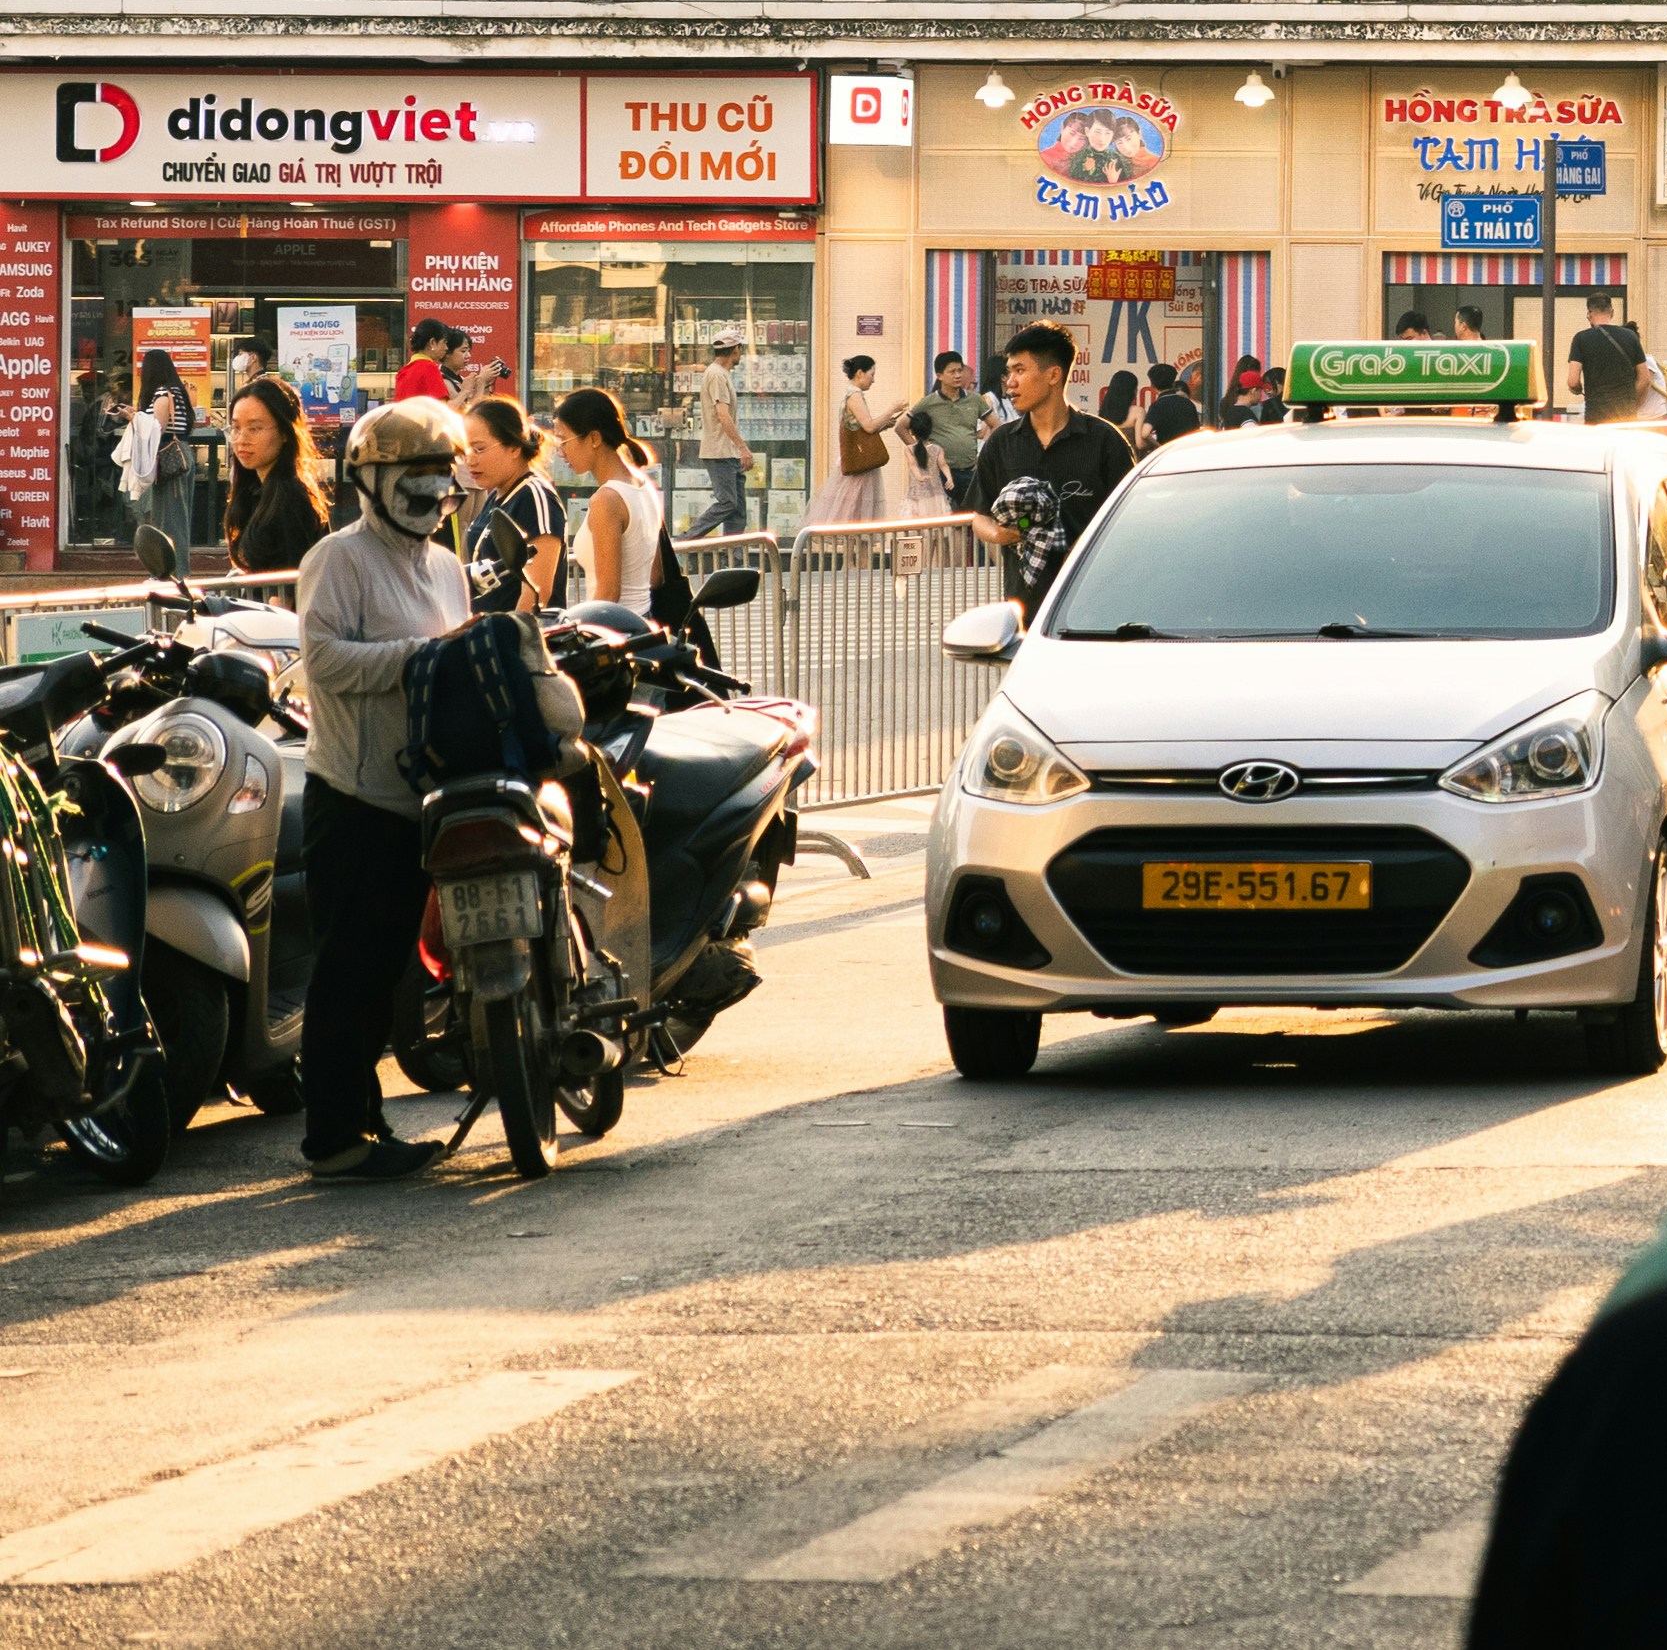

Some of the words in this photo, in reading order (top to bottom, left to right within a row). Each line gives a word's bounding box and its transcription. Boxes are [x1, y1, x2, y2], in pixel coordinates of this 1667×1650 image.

[1020, 86, 1082, 130] HỒNG
[1088, 80, 1133, 104] TRÀ
[1136, 93, 1178, 132] SỮA
[1385, 88, 1477, 123] HỒNG
[1484, 92, 1553, 123] TRÀ
[1556, 93, 1623, 125] SỮA
[624, 102, 707, 132] THU
[717, 94, 774, 133] CŨ
[618, 141, 689, 180] ĐỔI
[700, 139, 776, 181] MỚI
[1413, 137, 1500, 171] TAM
[1571, 147, 1588, 160] PHỐ
[162, 152, 226, 183] CHUYỂN
[232, 162, 271, 183] GIAO
[279, 157, 305, 183] GIÁ
[315, 164, 341, 188] TRỊ
[350, 161, 396, 188] VƯỢT
[405, 158, 442, 188] TRỘI
[1556, 164, 1582, 184] HÀNG
[1584, 168, 1601, 184] GAI
[1036, 176, 1100, 220] TAM
[1483, 200, 1514, 214] PHỐ
[7, 224, 28, 232] Havit
[95, 217, 117, 229] Tax
[121, 217, 168, 229] Refund
[171, 217, 207, 229] Store
[217, 216, 242, 229] Cửa
[247, 217, 280, 231] Hàng
[283, 216, 318, 229] Hoàn
[321, 215, 355, 229] Thuế
[358, 218, 397, 231] (GST)
[540, 221, 606, 233] Affordable
[609, 221, 656, 232] Phones
[658, 220, 684, 231] And
[686, 220, 716, 231] Tech
[718, 220, 771, 234] Gadgets
[773, 220, 808, 231] Store
[1451, 216, 1470, 239] LÊ
[1474, 216, 1511, 240] THÁI
[1516, 215, 1535, 240] TỔ
[15, 242, 51, 253] AUKEY
[274, 244, 316, 255] APPLE
[425, 255, 459, 274] PHỤ
[462, 251, 498, 274] KIỆN
[0, 264, 53, 276] AMSUNG
[411, 274, 462, 292] CHÍNH
[466, 274, 513, 292] HÃNG
[1031, 276, 1061, 293] TRÀ
[16, 286, 44, 298] Zoda
[415, 301, 452, 310] PREMIUM
[453, 301, 510, 310] ACCESSORIES
[0, 312, 30, 325] AGG
[35, 314, 54, 323] Havit
[294, 321, 310, 329] SIM
[25, 338, 44, 347] UAG
[0, 354, 51, 379] Apple
[1320, 348, 1406, 376] Grab
[1414, 350, 1491, 376] Taxi
[21, 388, 50, 398] SONY
[10, 406, 53, 421] OPPO
[0, 427, 19, 437] eelot
[10, 446, 50, 460] Mophie
[0, 469, 26, 478] aseus
[29, 468, 52, 481] JBL
[10, 492, 50, 502] UGREEN
[0, 509, 12, 518] Fit
[21, 516, 50, 528] Havit
[901, 555, 918, 567] STOP
[1161, 871, 1351, 901] 29E-551.67
[458, 907, 530, 940] 2661
